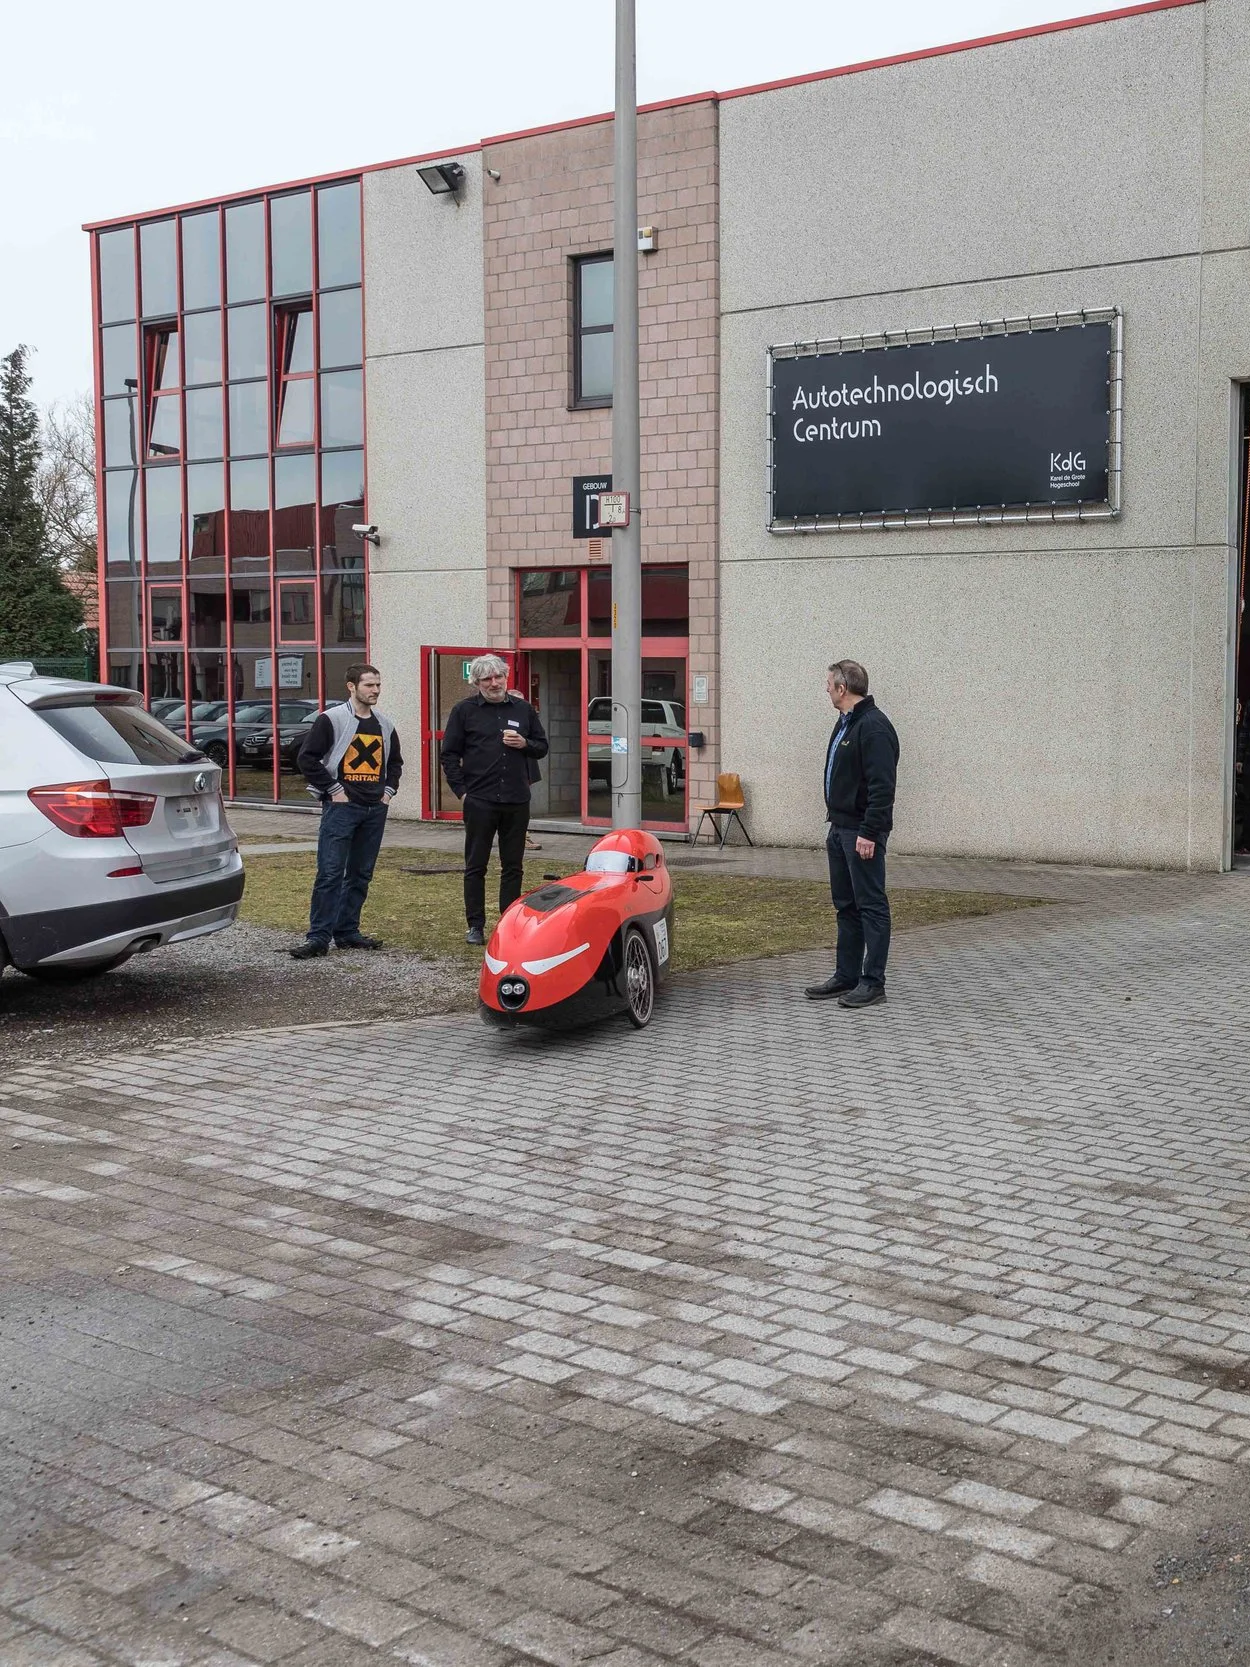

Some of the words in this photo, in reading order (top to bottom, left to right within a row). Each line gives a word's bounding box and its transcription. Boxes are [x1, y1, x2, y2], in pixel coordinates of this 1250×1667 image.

[792, 364, 998, 410] Autotechnologisch
[793, 416, 881, 442] Centrum
[1050, 451, 1086, 472] KdG
[1071, 473, 1086, 481] Grote
[583, 482, 607, 490] GEBOUW
[1050, 481, 1080, 489] Hogeschool
